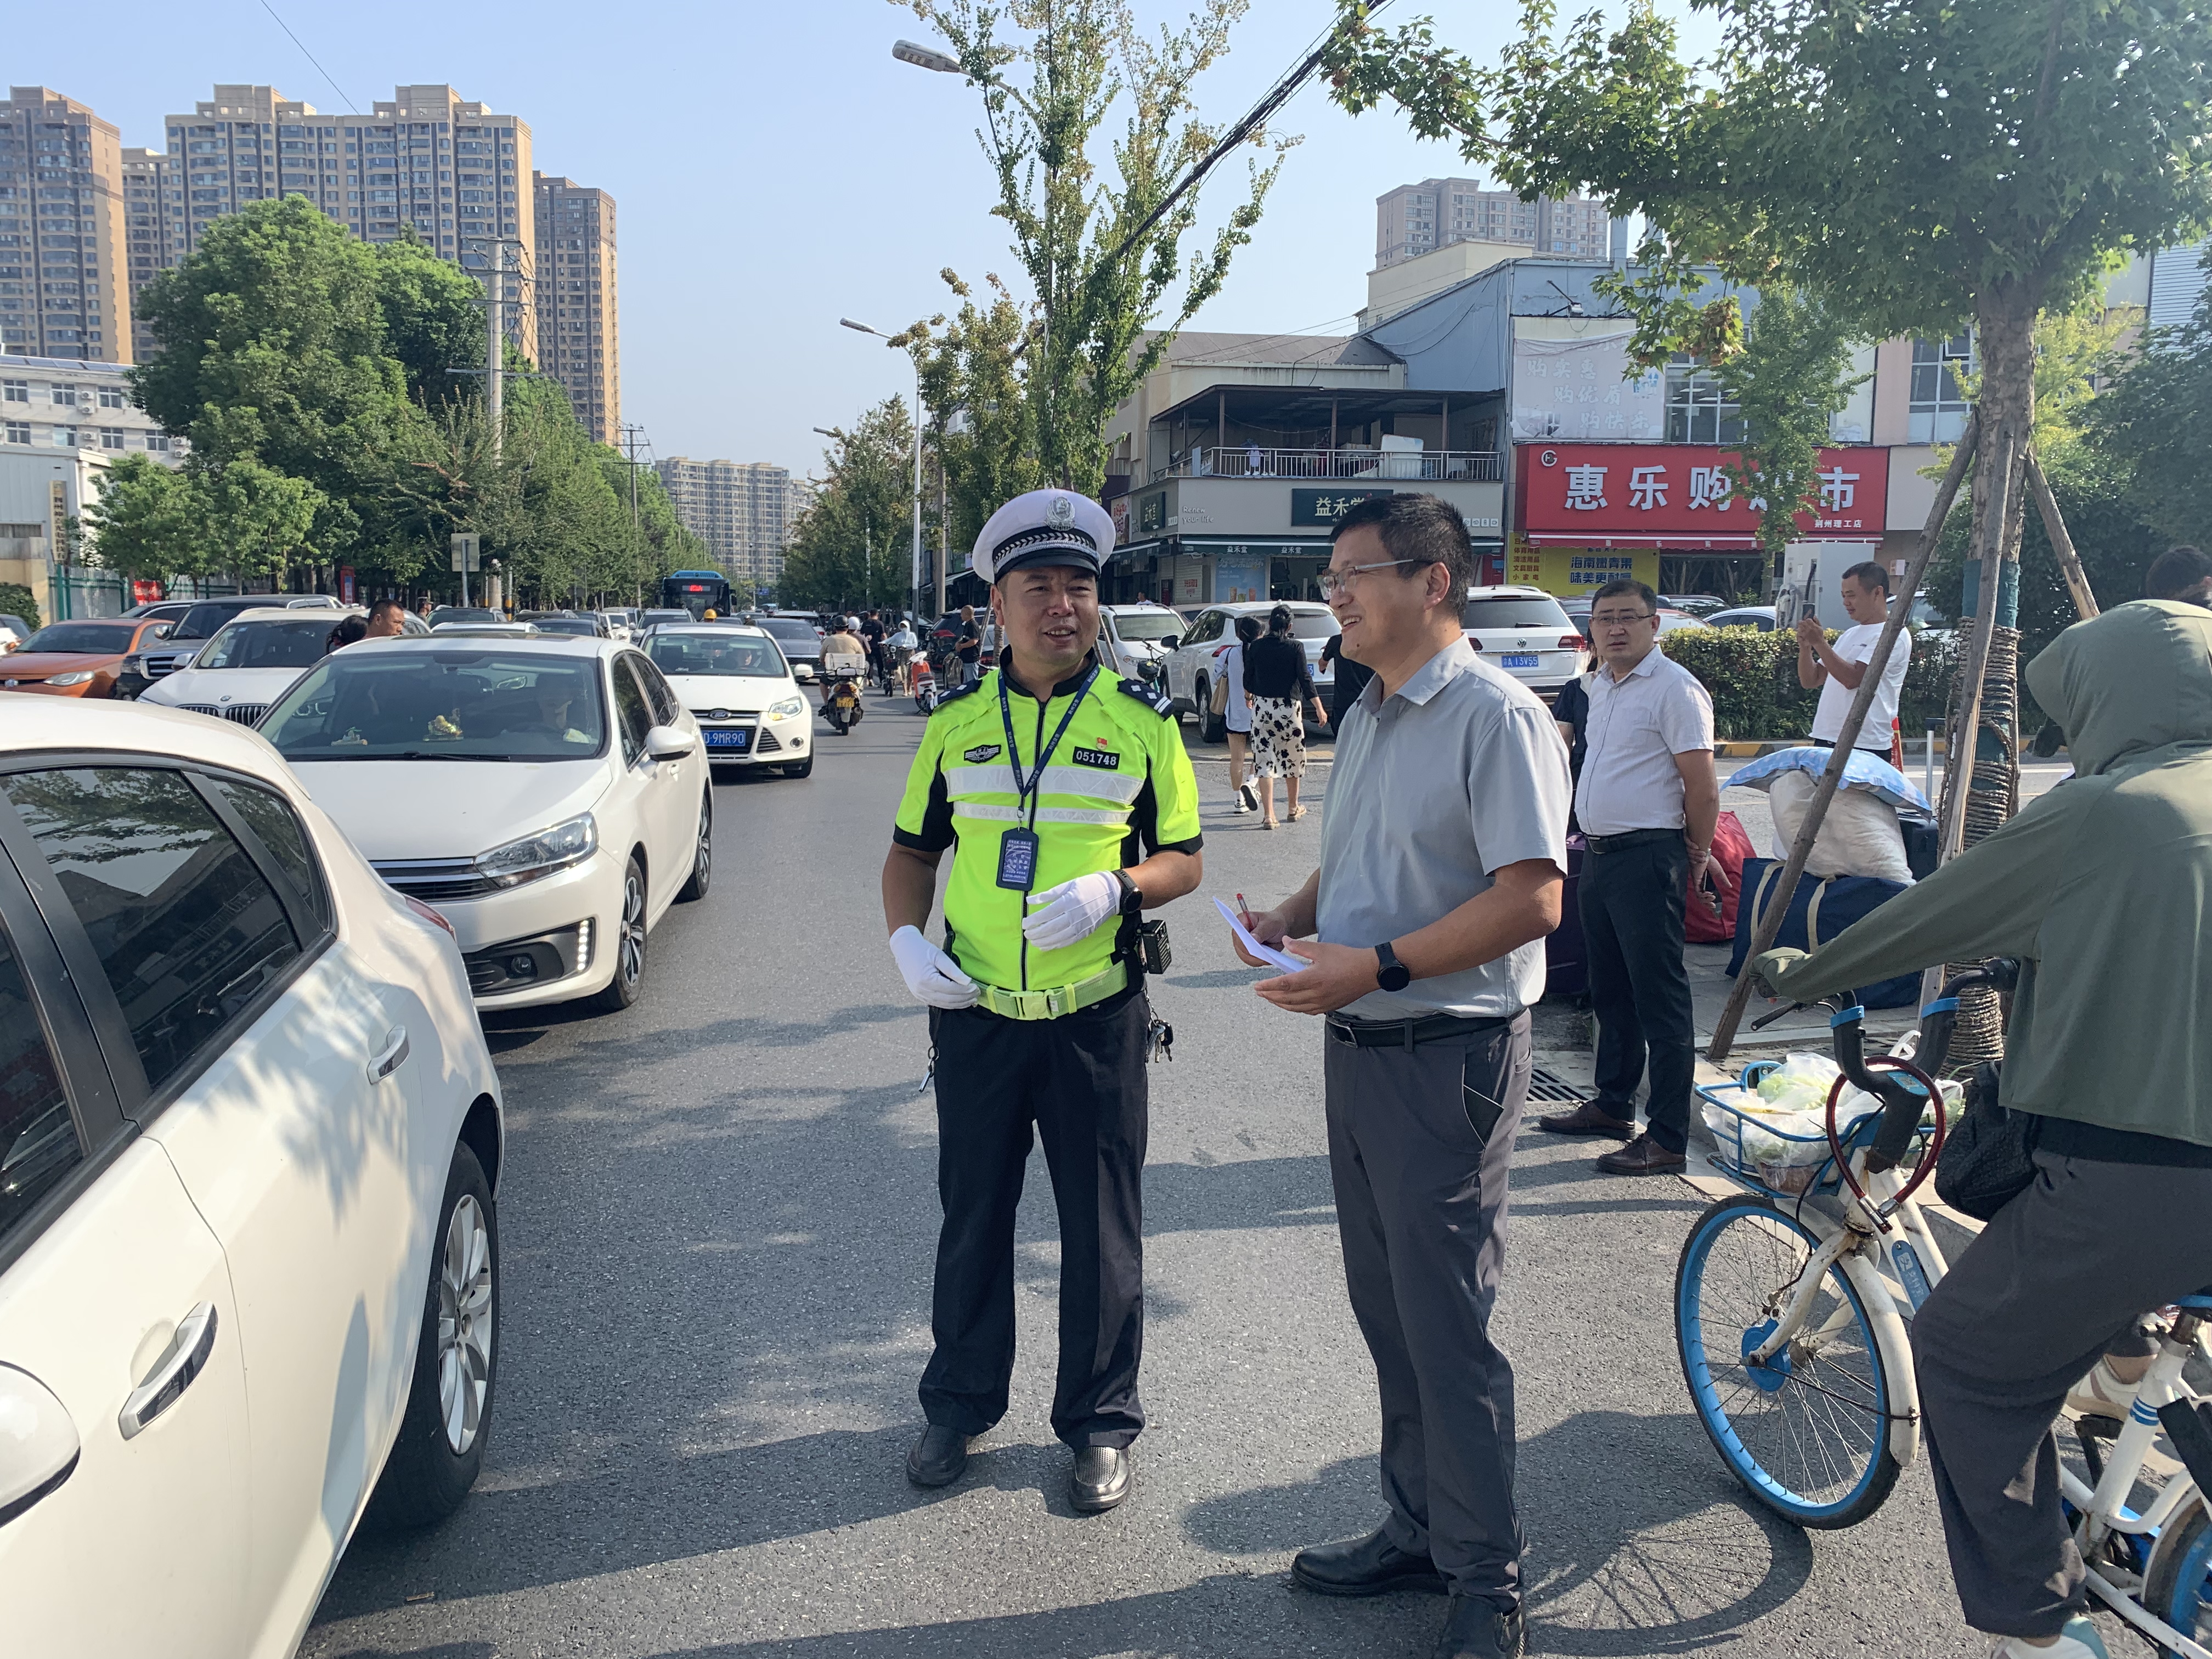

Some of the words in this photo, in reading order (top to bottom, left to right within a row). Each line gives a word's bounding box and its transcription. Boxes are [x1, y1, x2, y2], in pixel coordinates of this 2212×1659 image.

[1526, 358, 1597, 380] 购实惠
[1554, 385, 1622, 405] 购优质
[1579, 410, 1650, 430] 购快乐
[1814, 519, 1863, 528] 荆州理工店
[1227, 545, 1248, 554] 益禾堂
[1281, 546, 1302, 554] 益禾堂
[1076, 750, 1116, 766] 051748
